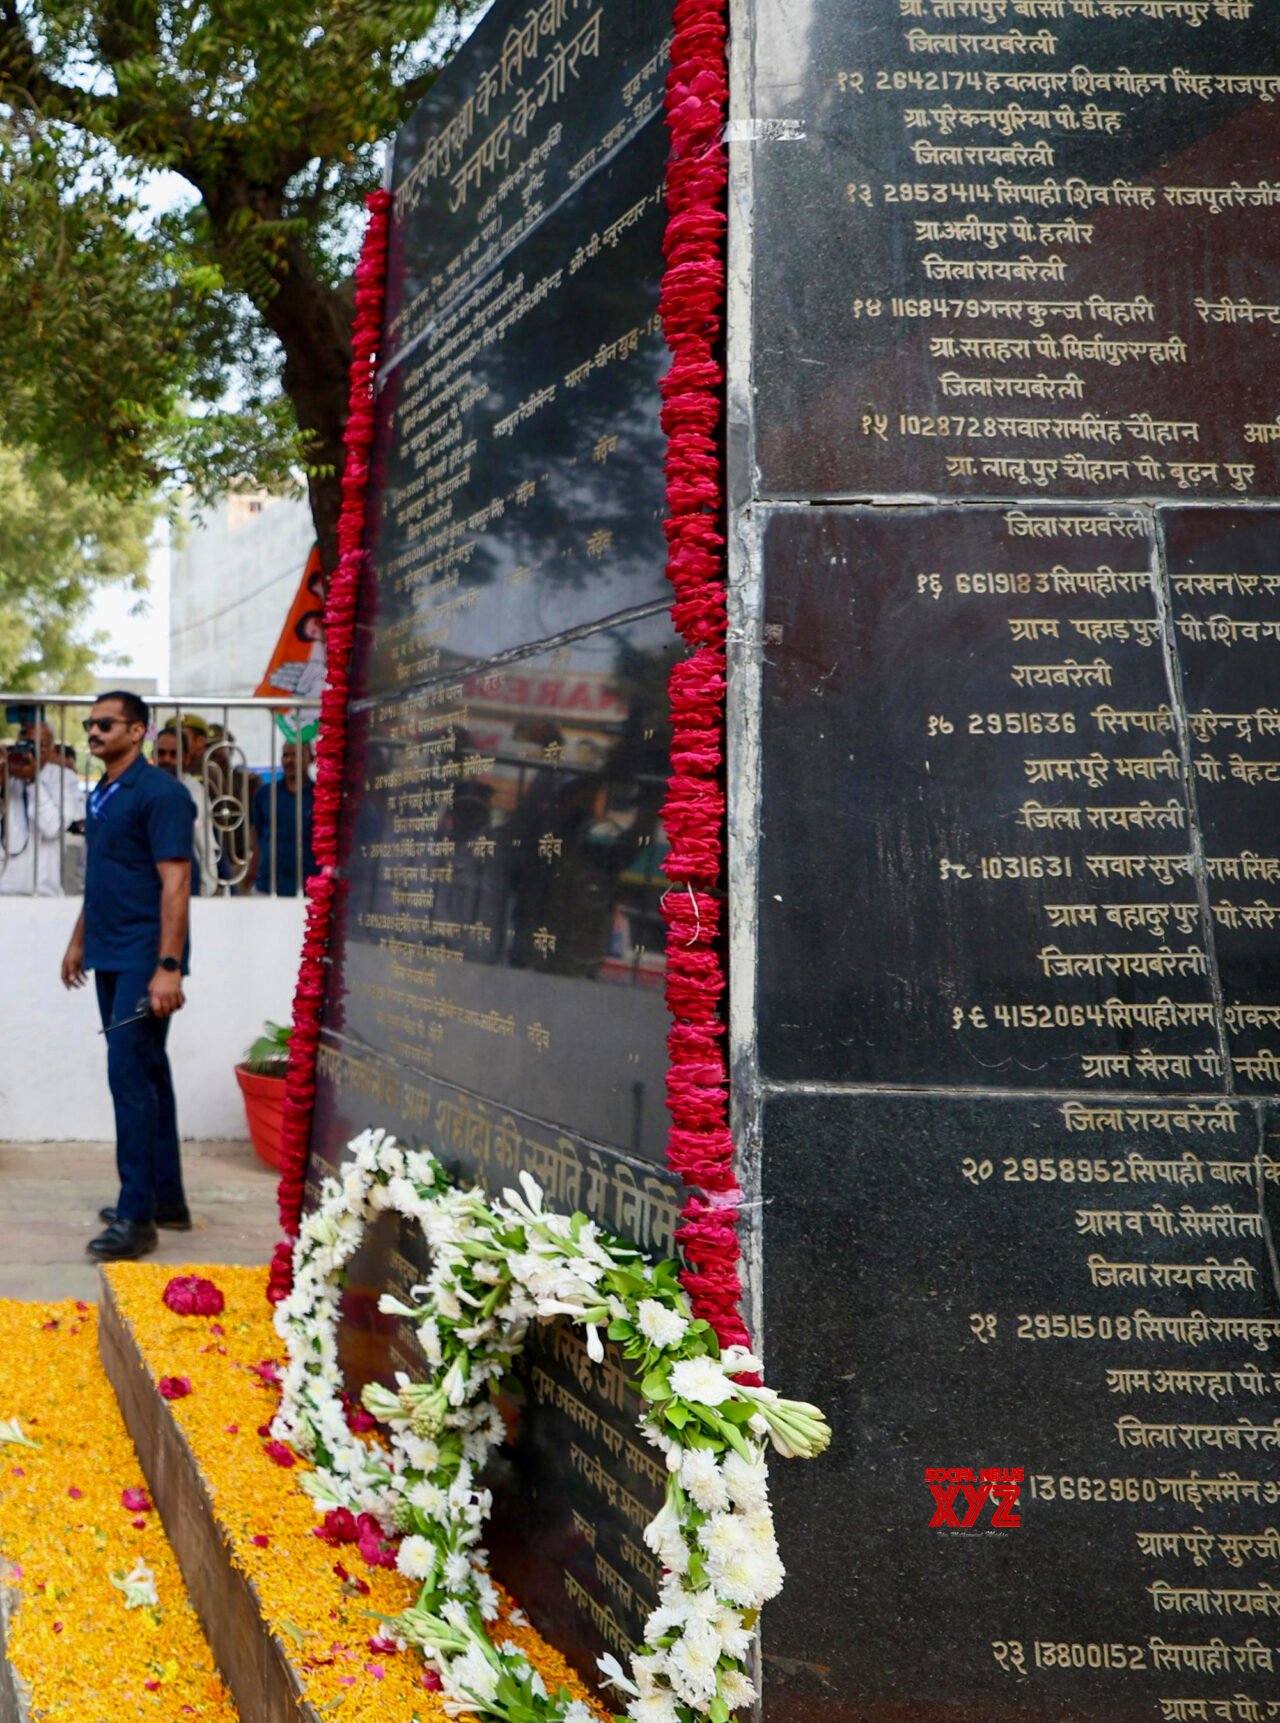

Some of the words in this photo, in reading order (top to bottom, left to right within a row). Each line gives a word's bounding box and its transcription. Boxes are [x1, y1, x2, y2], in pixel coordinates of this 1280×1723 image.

[476, 64, 500, 117] के
[837, 72, 864, 94] १२
[876, 71, 982, 90] 2642174
[1069, 65, 1111, 96] शिव
[1112, 67, 1168, 97] मोहन
[1170, 67, 1214, 99] सिंह
[1081, 103, 1126, 135] डीह
[449, 115, 511, 213] जनपद
[513, 86, 536, 138] के
[911, 139, 964, 165] जिला
[965, 140, 1054, 167] रायबरेली
[847, 182, 874, 207] १३
[883, 183, 992, 203] 2953414
[1064, 178, 1109, 209] शिव
[1111, 179, 1156, 210] सिंह
[1163, 186, 1233, 214] राजपूत
[942, 215, 1008, 249] अलीपुर
[1037, 218, 1095, 247] हलोर
[922, 253, 974, 280] जिला
[975, 254, 1068, 281] रायबरेली
[852, 300, 882, 319] १४
[891, 299, 981, 318] 1168479
[980, 300, 1023, 319] गनर
[1084, 294, 1155, 326] बिहारी
[938, 371, 993, 396] जिला
[993, 372, 1085, 399] रायबरेली
[861, 414, 888, 441] १५
[899, 414, 997, 437] 1028728
[997, 417, 1053, 438] सवार
[1122, 413, 1200, 445] चौहान
[1004, 511, 1058, 537] जिला
[916, 574, 944, 600] १६
[955, 572, 1051, 594] 6619183
[1051, 565, 1118, 597] सिपाही
[1008, 619, 1060, 640] ग्राम
[1011, 658, 1112, 687] रायबरेली
[928, 715, 954, 736] १७
[968, 712, 1076, 734] 2951636
[1090, 704, 1176, 736] सिपाही
[1020, 800, 1082, 831] जिला
[1086, 799, 1185, 831] रायबरेली
[980, 856, 1072, 879] 1031631
[1084, 855, 1149, 879] सवार
[1043, 904, 1098, 927] ग्राम
[1037, 944, 1105, 977] जिला
[1105, 945, 1209, 977] रायबरेली
[994, 1004, 1105, 1028] 4152064
[1103, 996, 1176, 1032] सिपाही
[1080, 1054, 1131, 1079] ग्राम
[1059, 1102, 1124, 1132] जिला
[1124, 1102, 1240, 1135] रायबरेली
[962, 1157, 994, 1185] २०
[1002, 1157, 1129, 1182] 2958952
[1125, 1152, 1204, 1188] सिपाही
[1075, 1210, 1122, 1236] ग्राम
[1087, 1253, 1148, 1287] जिला
[1149, 1256, 1257, 1291] रायबरेली
[969, 1313, 997, 1344] २१
[1016, 1314, 1132, 1341] 2951508
[1131, 1308, 1211, 1347] सिपाही
[1105, 1369, 1151, 1394] ग्राम
[599, 1419, 624, 1459] पर
[1113, 1414, 1178, 1448] जिला
[1030, 1474, 1157, 1502] 13662960
[1136, 1532, 1180, 1558] ग्राम
[1145, 1580, 1211, 1614] जिला
[991, 1641, 1028, 1674] २३
[1033, 1641, 1147, 1669] 13800152
[1148, 1636, 1231, 1675] सिपाही
[1158, 1698, 1208, 1721] ग्राम
